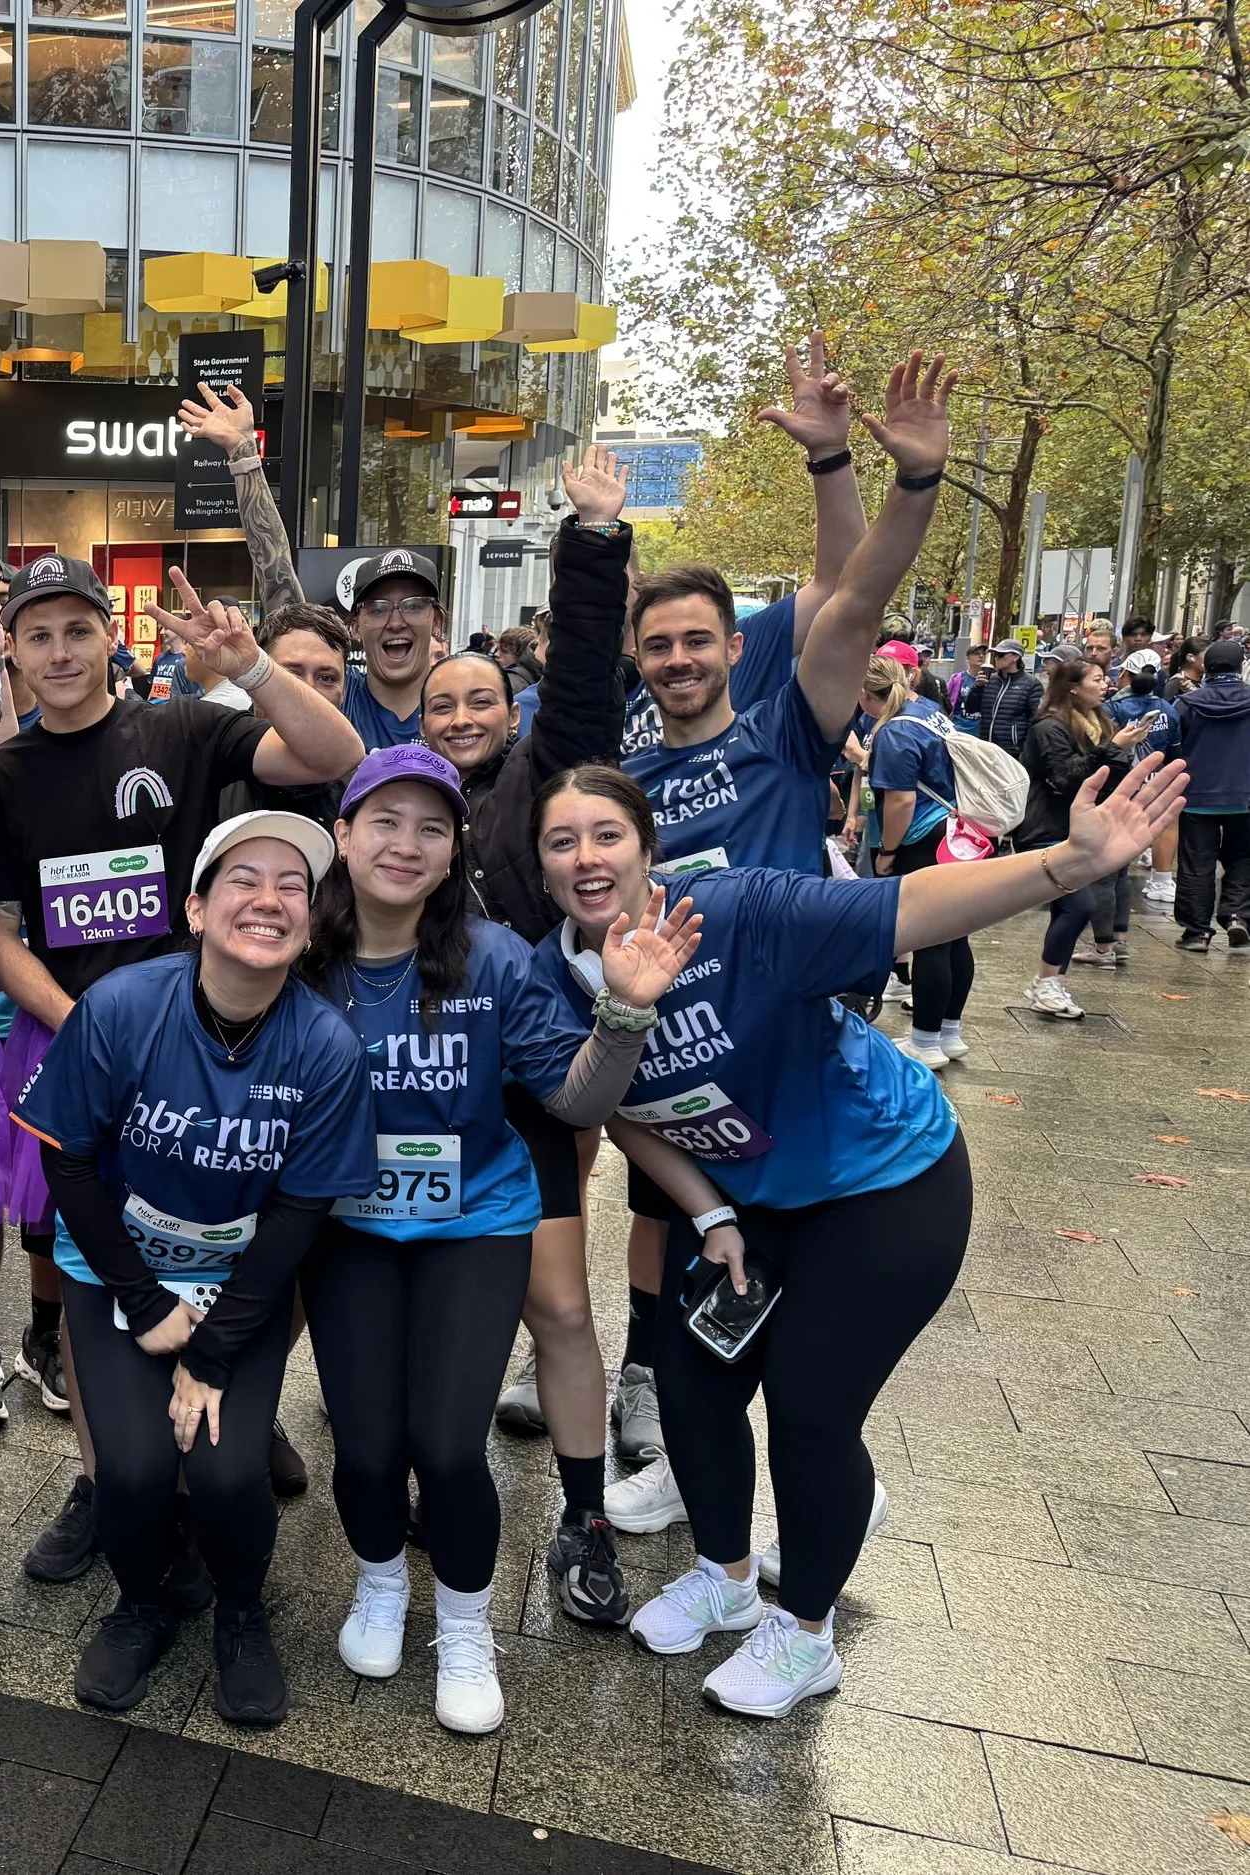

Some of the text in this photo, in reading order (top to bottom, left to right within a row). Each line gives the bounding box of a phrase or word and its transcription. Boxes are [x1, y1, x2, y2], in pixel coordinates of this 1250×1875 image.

[193, 357, 250, 367] State Government
[220, 368, 242, 376] Access
[235, 378, 242, 386] St
[66, 416, 192, 457] swat
[194, 460, 222, 468] Railway
[185, 508, 223, 516] Wellington
[196, 500, 225, 508] Through
[462, 496, 493, 512] nab
[486, 551, 519, 559] SEPHORA
[623, 703, 663, 740] un
[662, 761, 734, 806] run
[653, 784, 739, 828] REASON
[50, 862, 90, 875] hbf run
[111, 858, 146, 869] Specsavers
[50, 884, 161, 928] 16405
[80, 928, 115, 940] 12km
[127, 924, 137, 934] C
[665, 958, 722, 993] NEWS
[646, 1000, 723, 1055] run
[387, 1032, 469, 1068] run
[638, 1031, 735, 1081] REASON
[370, 1066, 468, 1091] REASON
[127, 1092, 290, 1153] hbf run
[654, 1117, 752, 1151] 6310
[120, 1124, 284, 1173] FOR A REASON
[399, 1145, 439, 1153] Specsavers
[356, 1170, 452, 1203] 975
[357, 1204, 394, 1216] 12km
[409, 1206, 418, 1216] E
[158, 1217, 181, 1229] run
